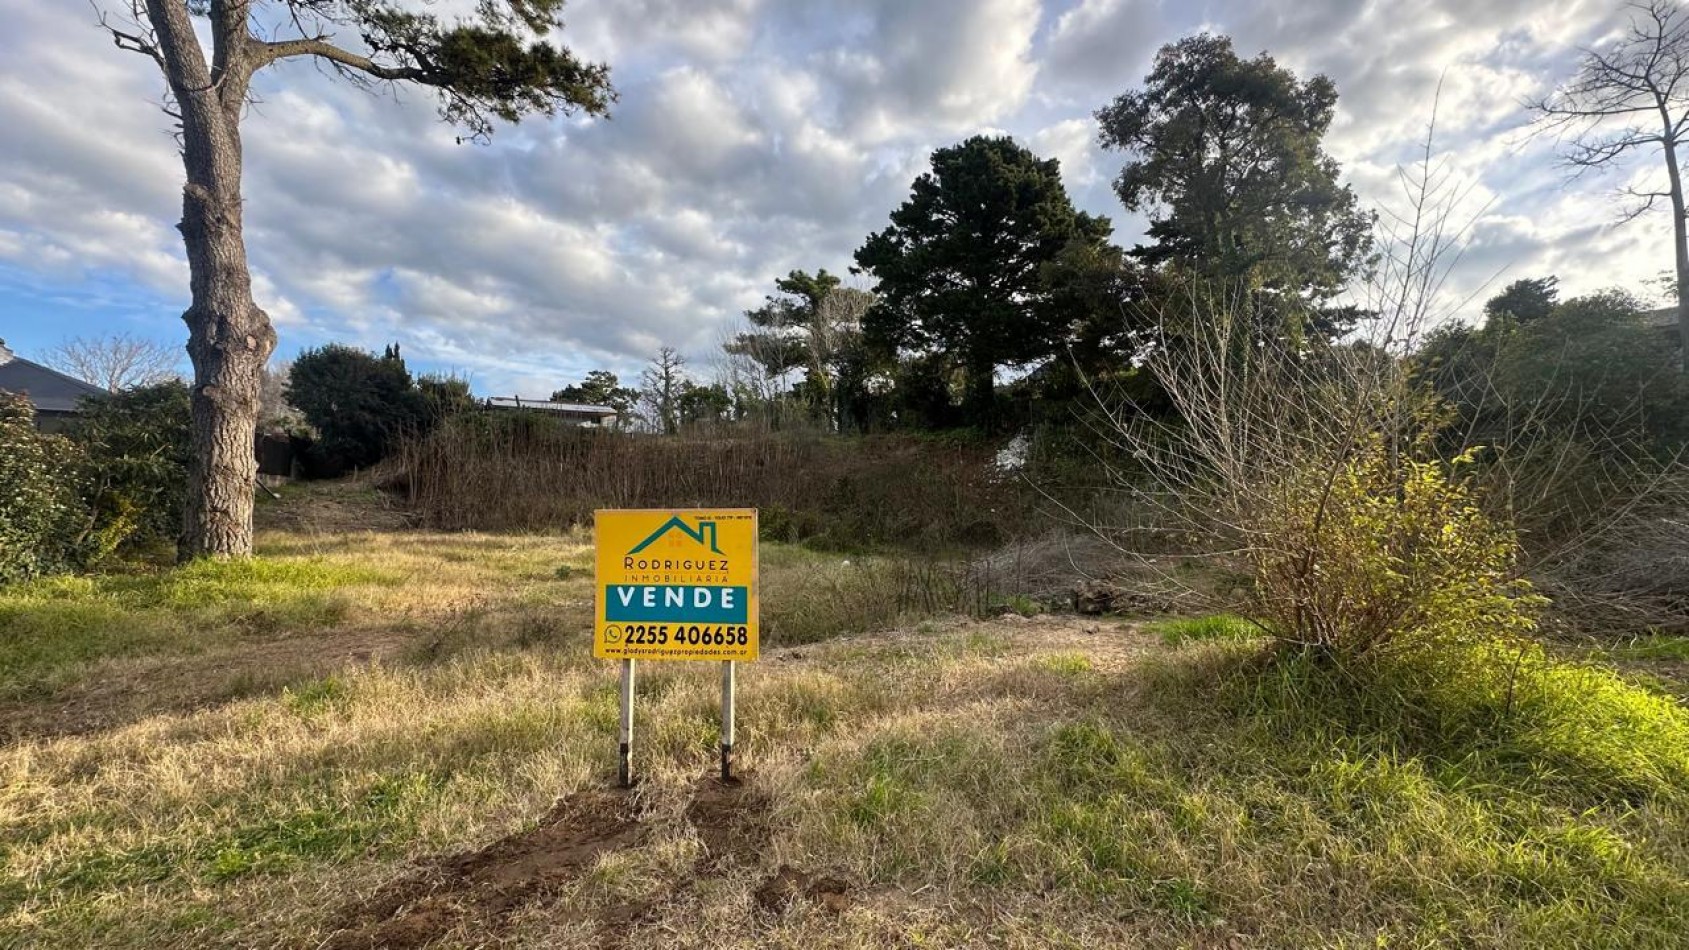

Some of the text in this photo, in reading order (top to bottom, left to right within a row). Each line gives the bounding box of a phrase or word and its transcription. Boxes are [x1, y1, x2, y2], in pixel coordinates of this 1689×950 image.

[625, 575, 728, 583] INMOBILIARIA
[617, 587, 734, 608] VENDE
[625, 625, 748, 645] 2255 406658
[605, 648, 747, 656] www.gladysrodriguezpropiedades.com.ar
